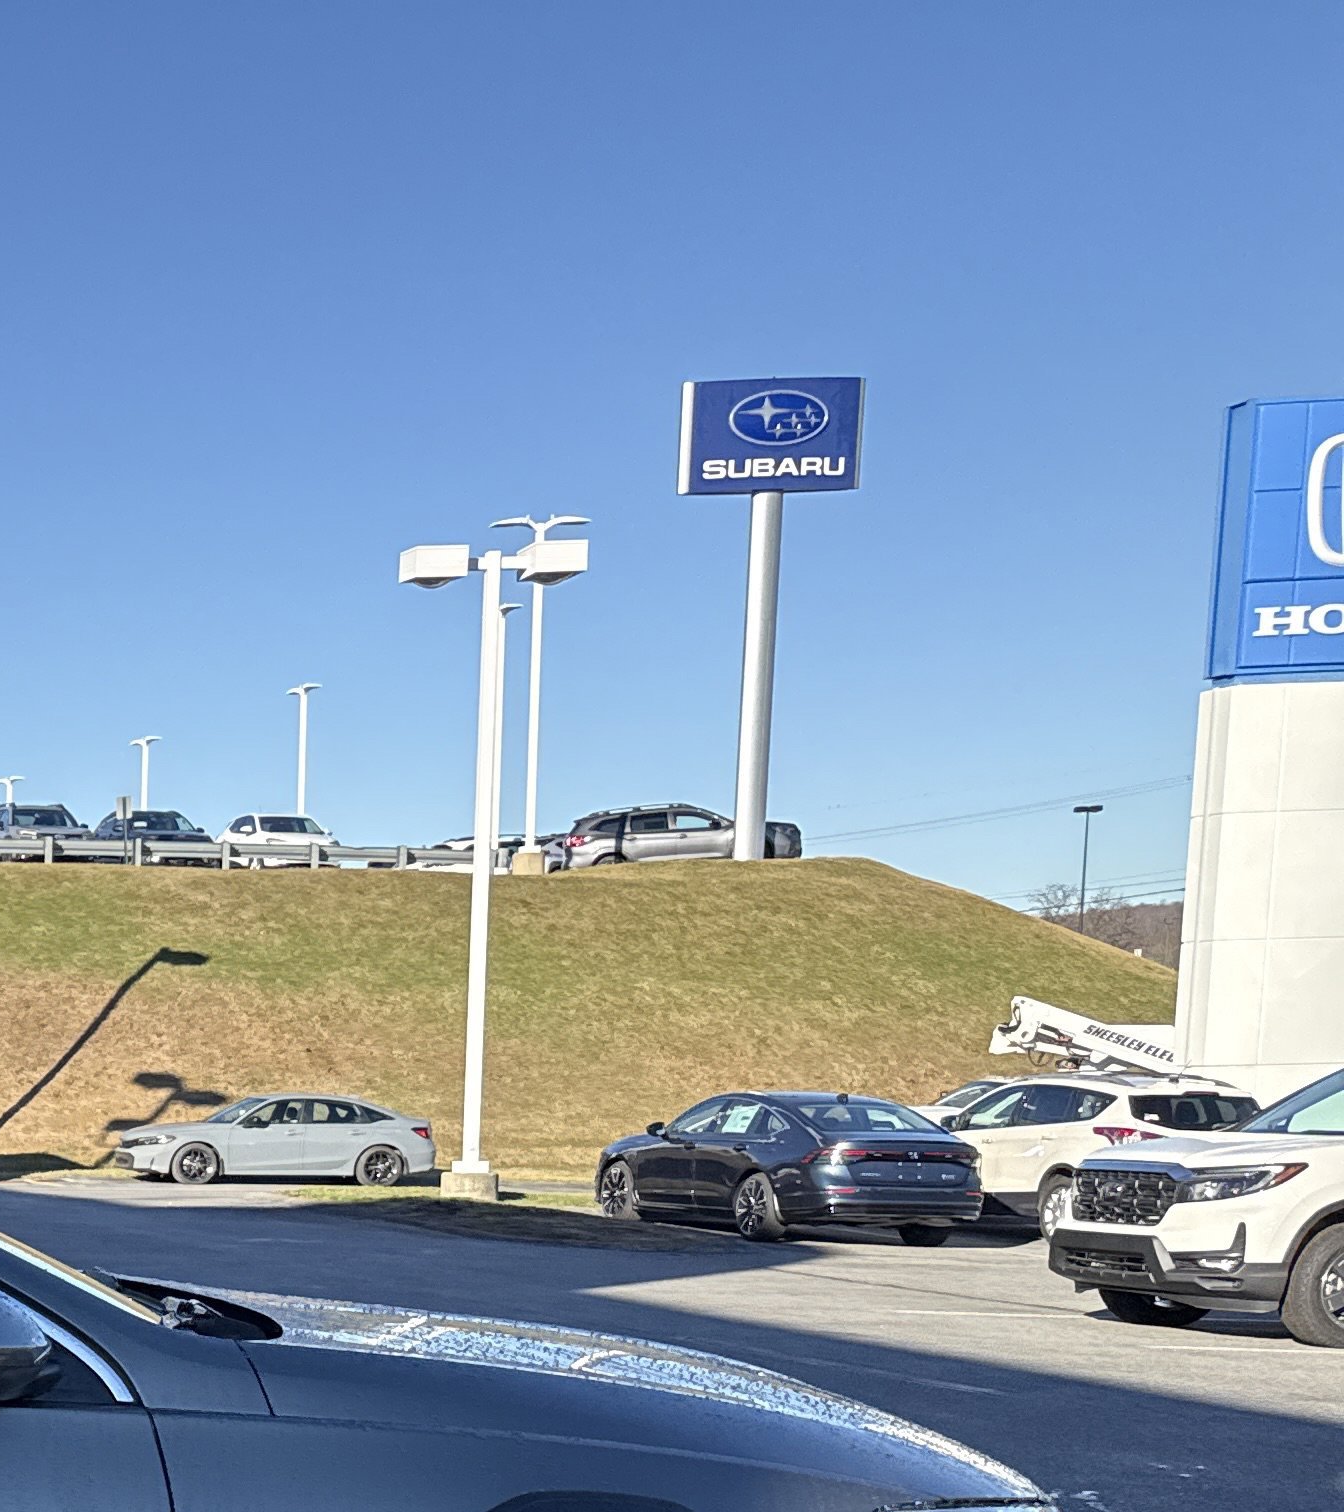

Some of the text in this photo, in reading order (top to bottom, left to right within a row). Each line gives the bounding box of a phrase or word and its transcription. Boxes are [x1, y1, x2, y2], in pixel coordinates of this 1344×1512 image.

[702, 456, 846, 480] SUBARU
[1252, 603, 1344, 637] HO
[1083, 1024, 1147, 1052] SHEESLEY
